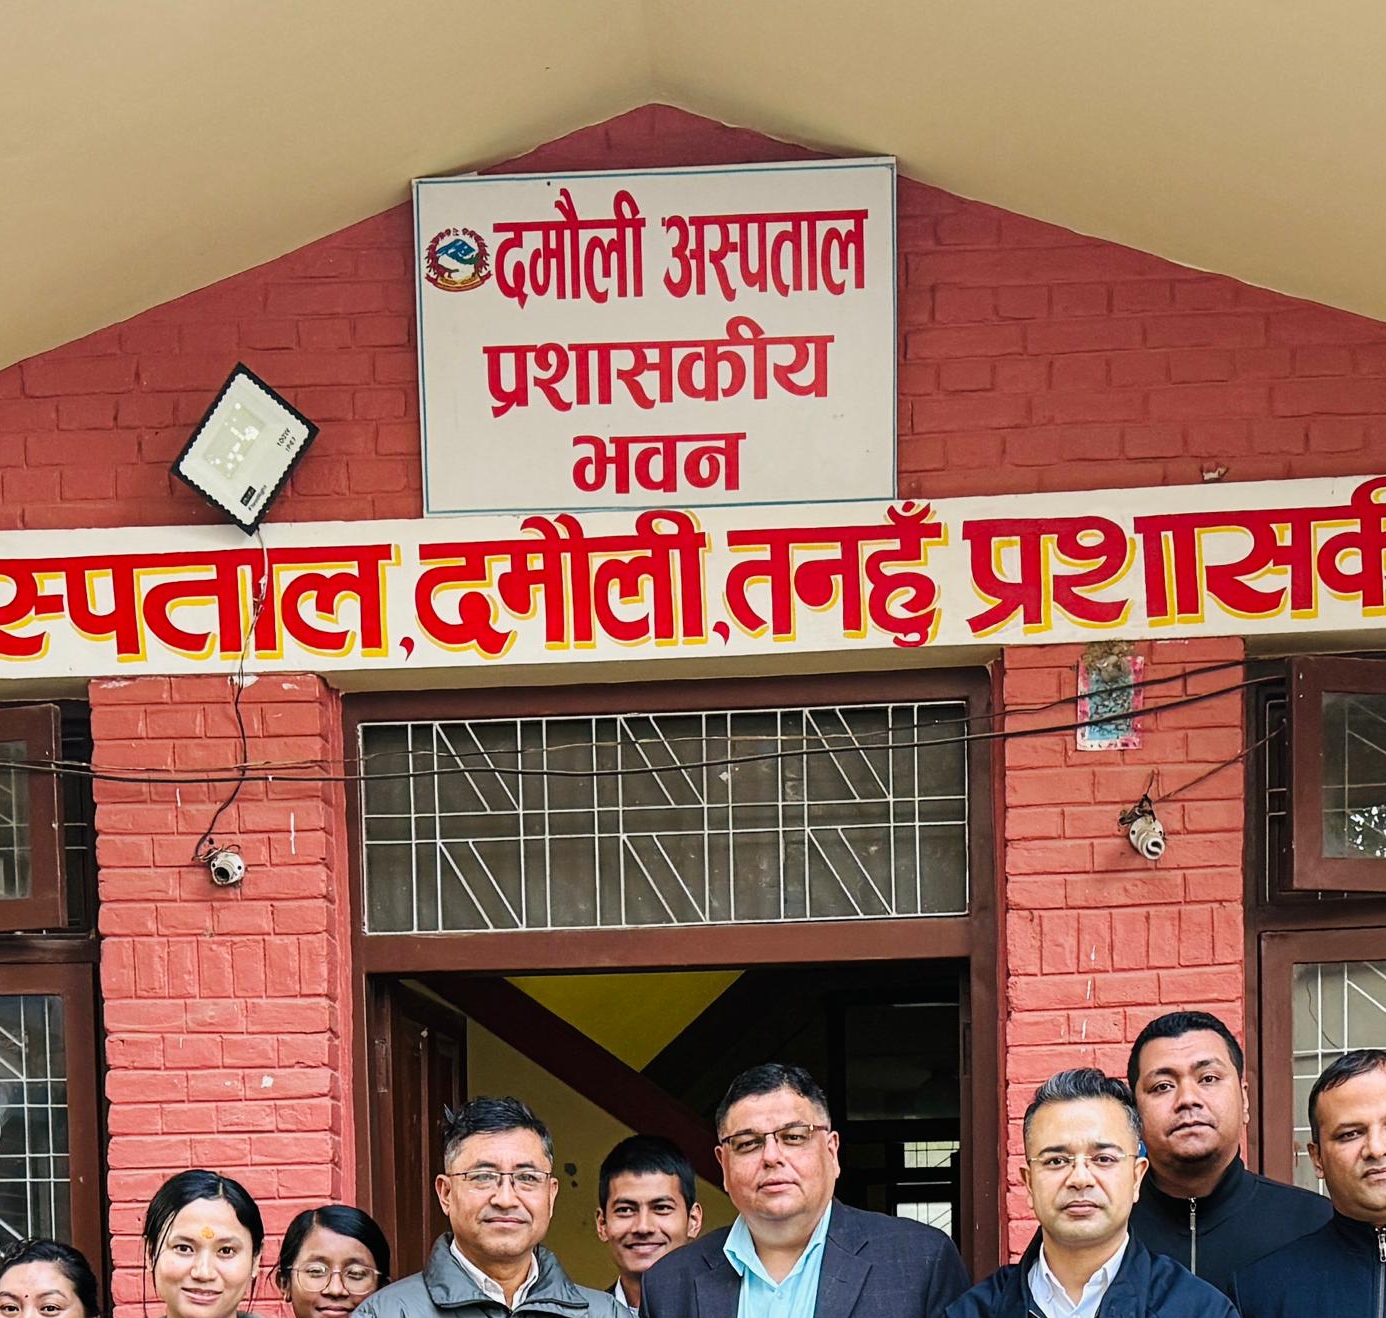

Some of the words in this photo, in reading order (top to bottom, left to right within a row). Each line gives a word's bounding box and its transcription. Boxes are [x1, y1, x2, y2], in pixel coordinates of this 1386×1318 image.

[493, 188, 647, 309] दमौली
[661, 209, 870, 302] अस्पताल
[482, 315, 835, 419] प्रशासकीय
[571, 431, 747, 495] भवन
[726, 500, 949, 648] तनहुँ
